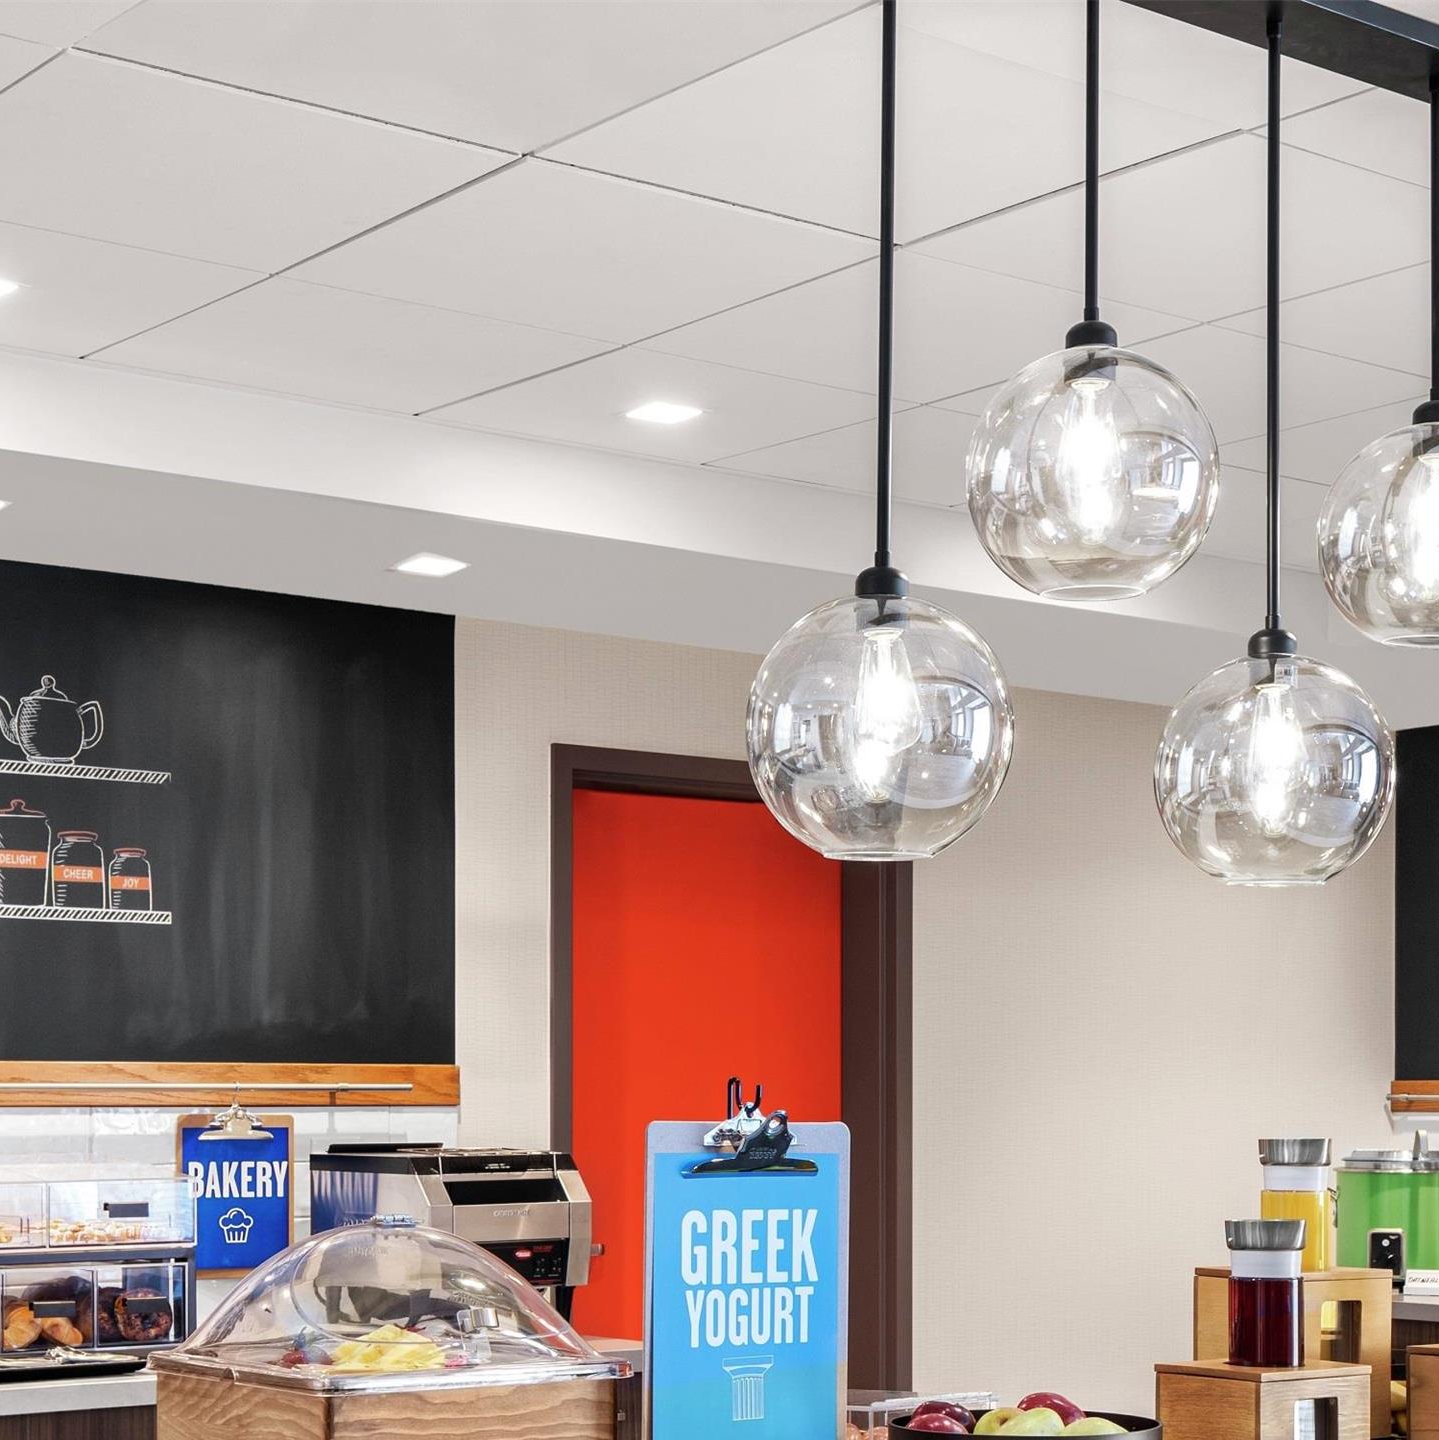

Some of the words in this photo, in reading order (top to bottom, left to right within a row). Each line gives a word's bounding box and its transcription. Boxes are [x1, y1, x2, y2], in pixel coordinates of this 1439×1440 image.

[0, 853, 38, 866] DELIGHT
[63, 868, 94, 880] CHEER
[122, 878, 140, 888] JOY
[188, 1161, 288, 1198] BAKERY
[681, 1208, 819, 1286] GREEK
[685, 1286, 814, 1348] YOGURT
